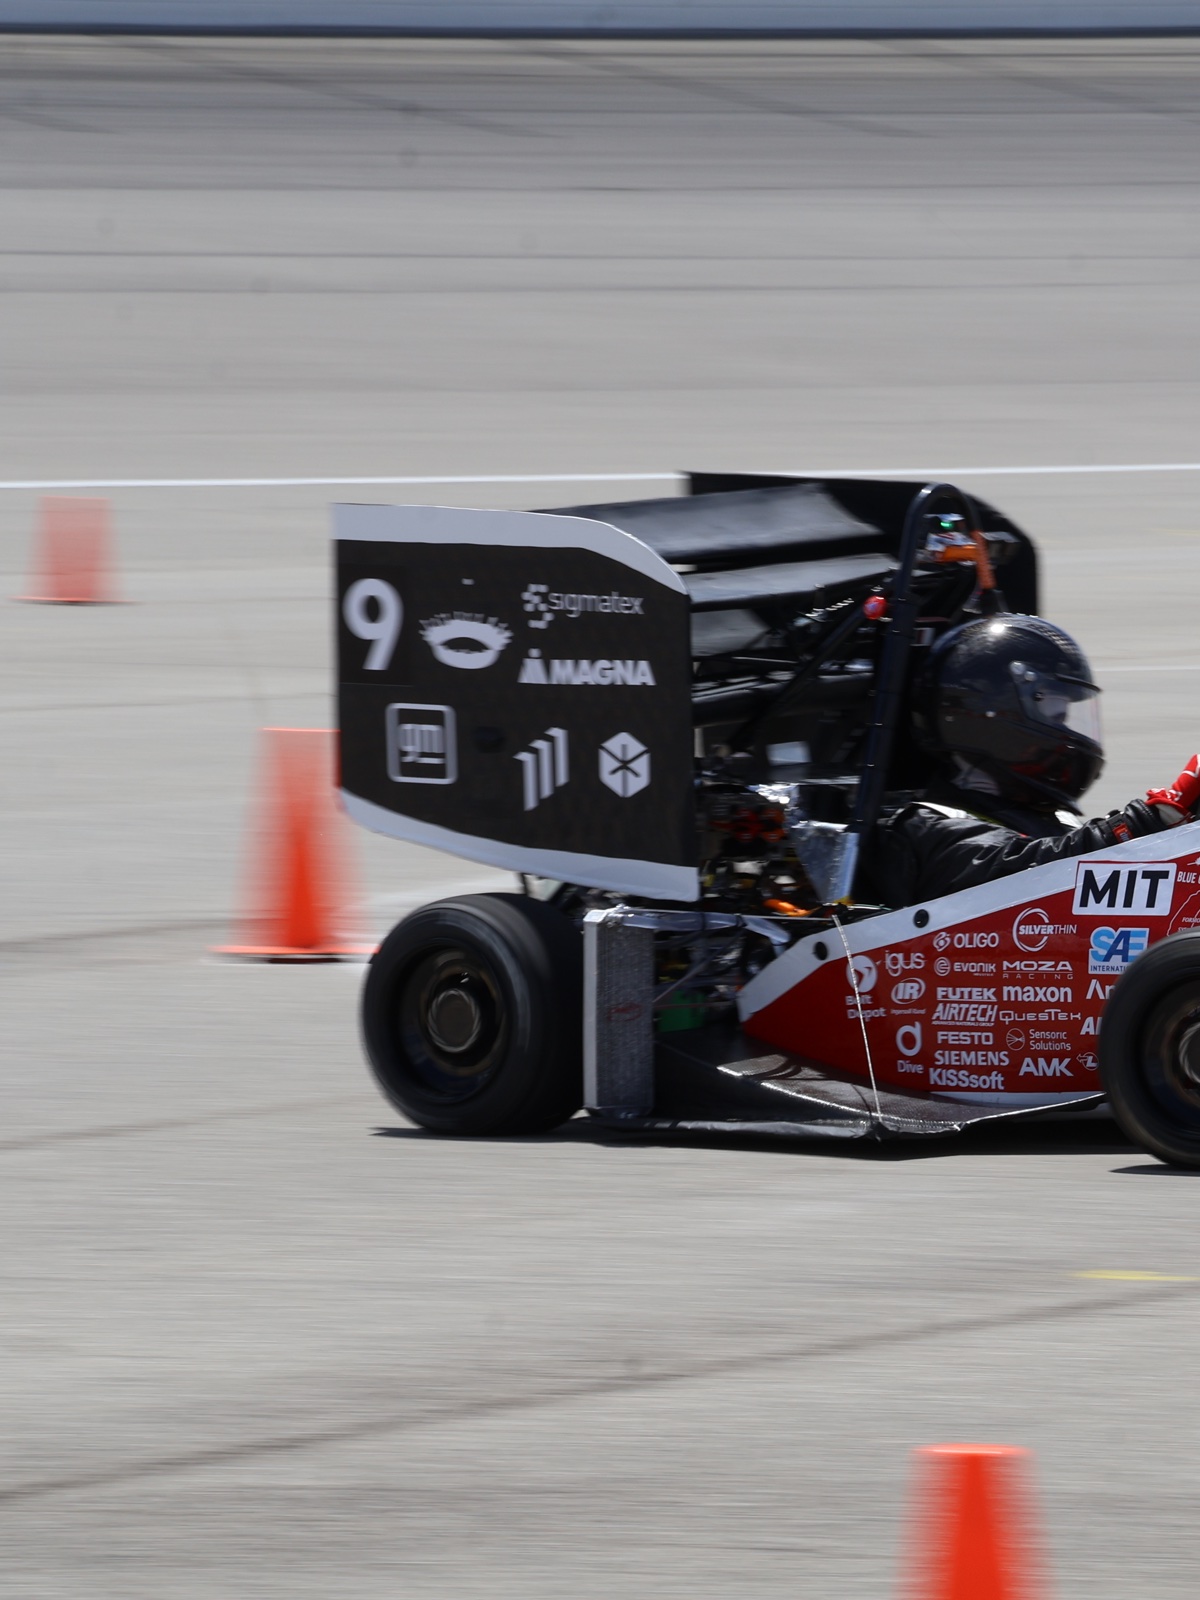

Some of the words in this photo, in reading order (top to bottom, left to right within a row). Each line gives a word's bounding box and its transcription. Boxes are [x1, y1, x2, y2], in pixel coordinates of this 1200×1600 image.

[549, 592, 645, 617] sigmatex
[343, 577, 404, 671] 9
[551, 659, 656, 686] MAGNA
[1177, 871, 1197, 884] BLUE
[1079, 869, 1170, 909] MIT
[1018, 925, 1077, 935] SILVERTHIN
[953, 932, 999, 948] OLIGO
[1090, 928, 1148, 962] SAE
[885, 950, 926, 977] igus
[1002, 961, 1073, 971] MOZA
[936, 987, 997, 1000] FUTEK
[1002, 986, 1072, 1003] maxon
[931, 1003, 998, 1021] AIRTECH
[937, 1031, 993, 1045] FESTO
[1029, 1029, 1067, 1040] Sensoric
[1030, 1041, 1071, 1051] Solutions
[934, 1050, 1010, 1066] SIEMENS
[897, 1060, 924, 1074] Dive
[1018, 1057, 1074, 1077] AMK
[928, 1068, 1005, 1090] KISSsoft
